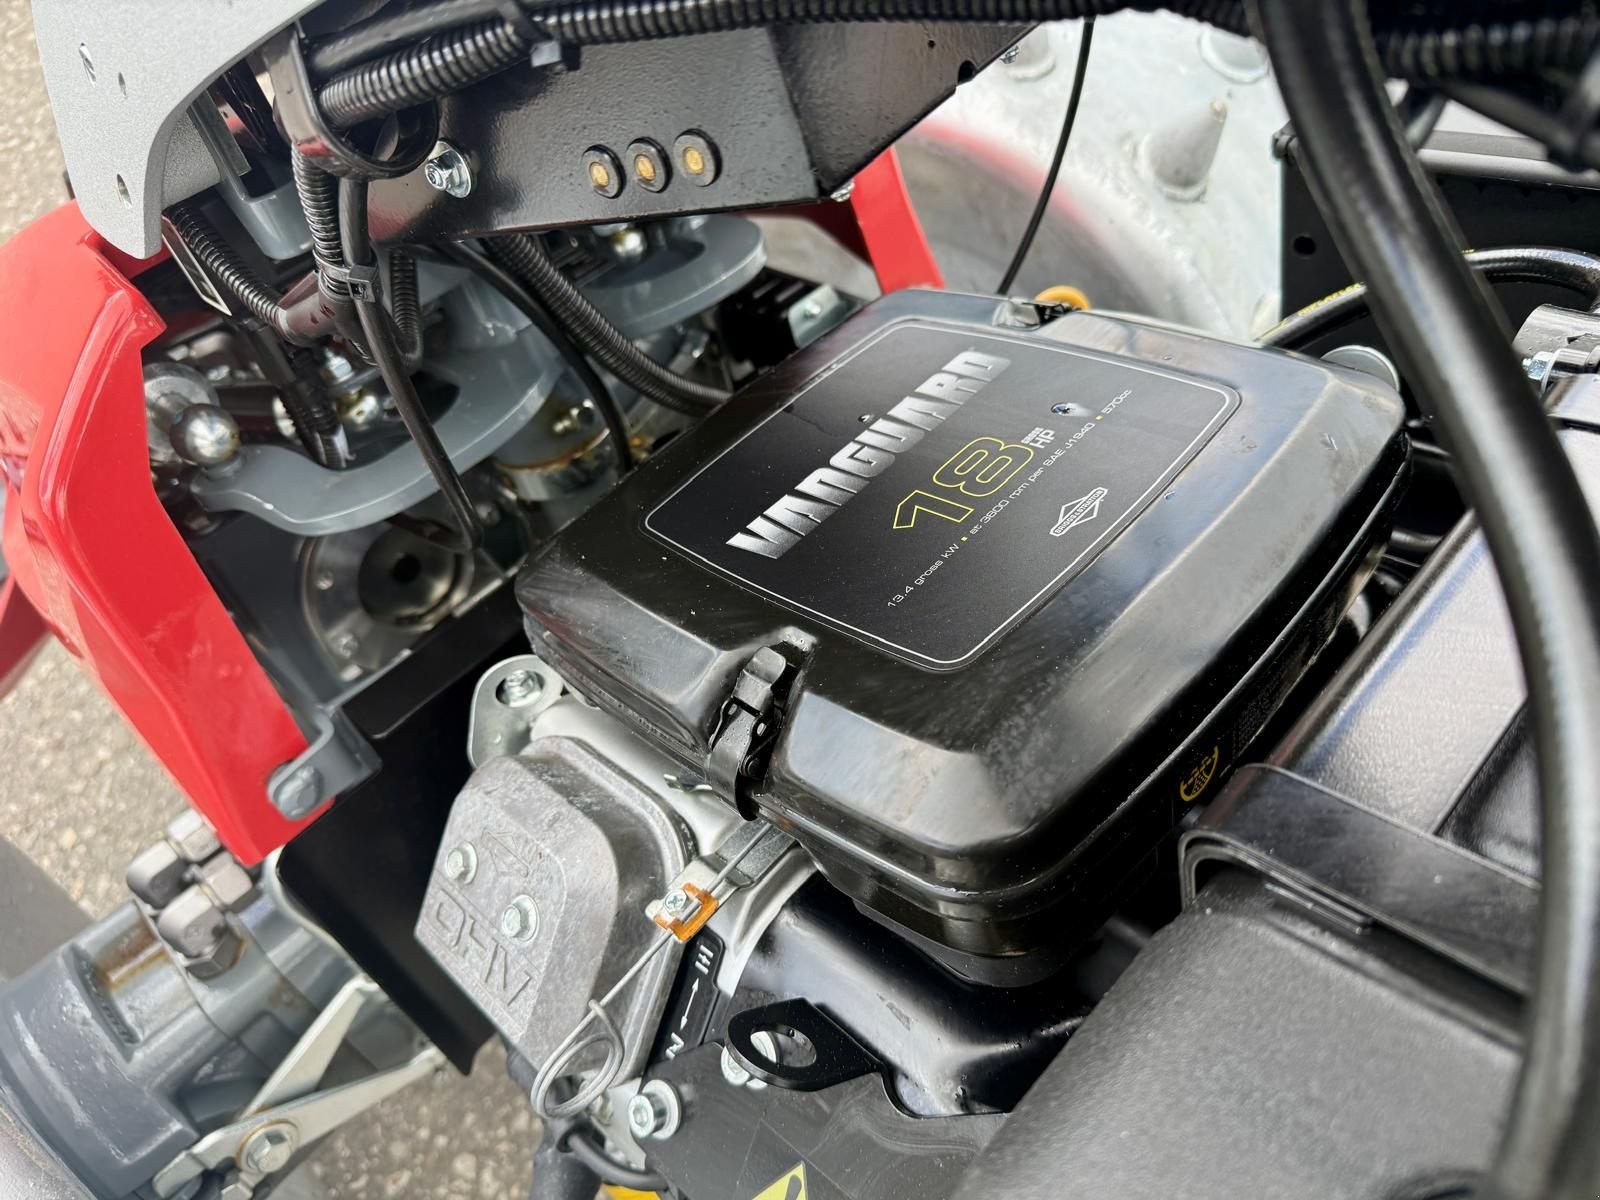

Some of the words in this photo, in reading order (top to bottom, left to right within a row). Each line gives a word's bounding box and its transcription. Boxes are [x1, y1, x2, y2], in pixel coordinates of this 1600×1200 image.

[726, 350, 1011, 560] VANGUARD
[887, 585, 914, 607] 13.4
[914, 560, 943, 585] gross
[940, 543, 960, 559] kW
[970, 524, 982, 535] at
[1009, 482, 1030, 500] rpm
[1028, 467, 1044, 483] per
[1043, 448, 1066, 467] SAE
[1101, 389, 1132, 414] 570cc
[892, 436, 1034, 529] 18
[1029, 429, 1055, 449] HP
[1054, 513, 1077, 534] BRIGGS
[1078, 490, 1104, 515] STRATTON
[434, 886, 535, 1008] OHV
